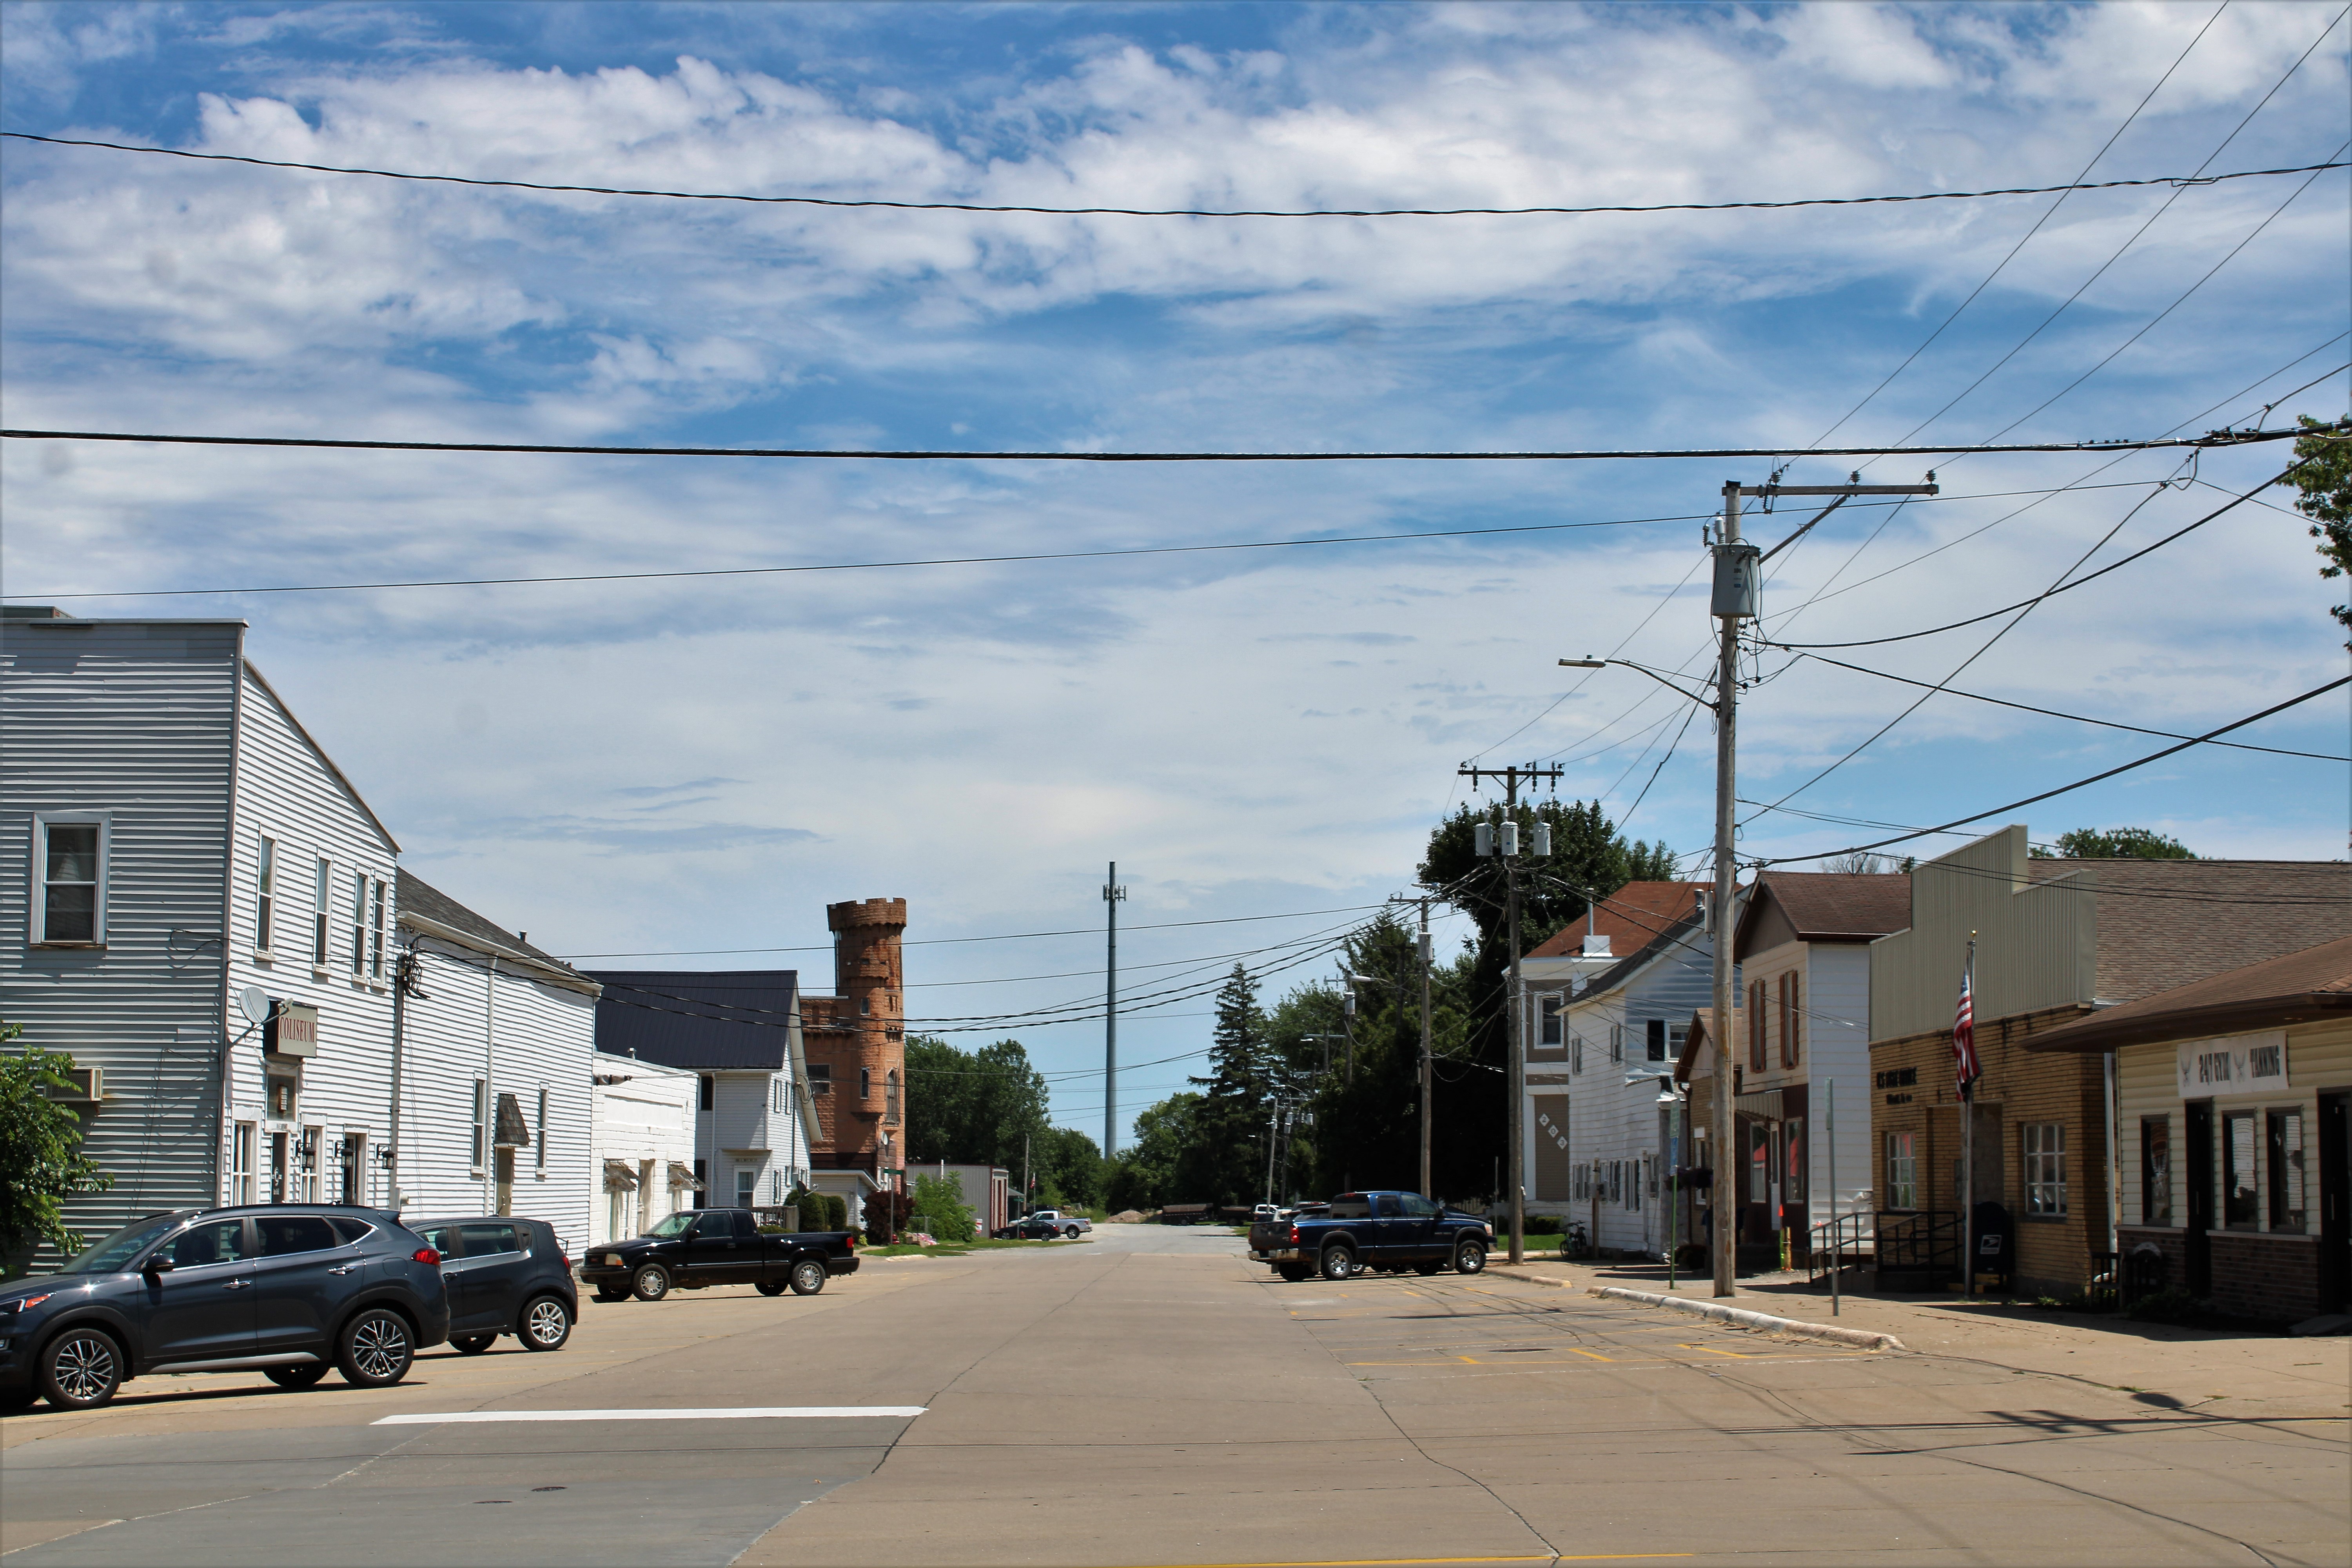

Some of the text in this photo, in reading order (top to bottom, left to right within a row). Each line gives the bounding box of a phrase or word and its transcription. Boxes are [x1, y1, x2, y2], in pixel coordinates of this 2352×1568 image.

[280, 1016, 314, 1042] COLISEUM
[2214, 1051, 2230, 1082] GYM
[2250, 1045, 2280, 1078] TANNING
